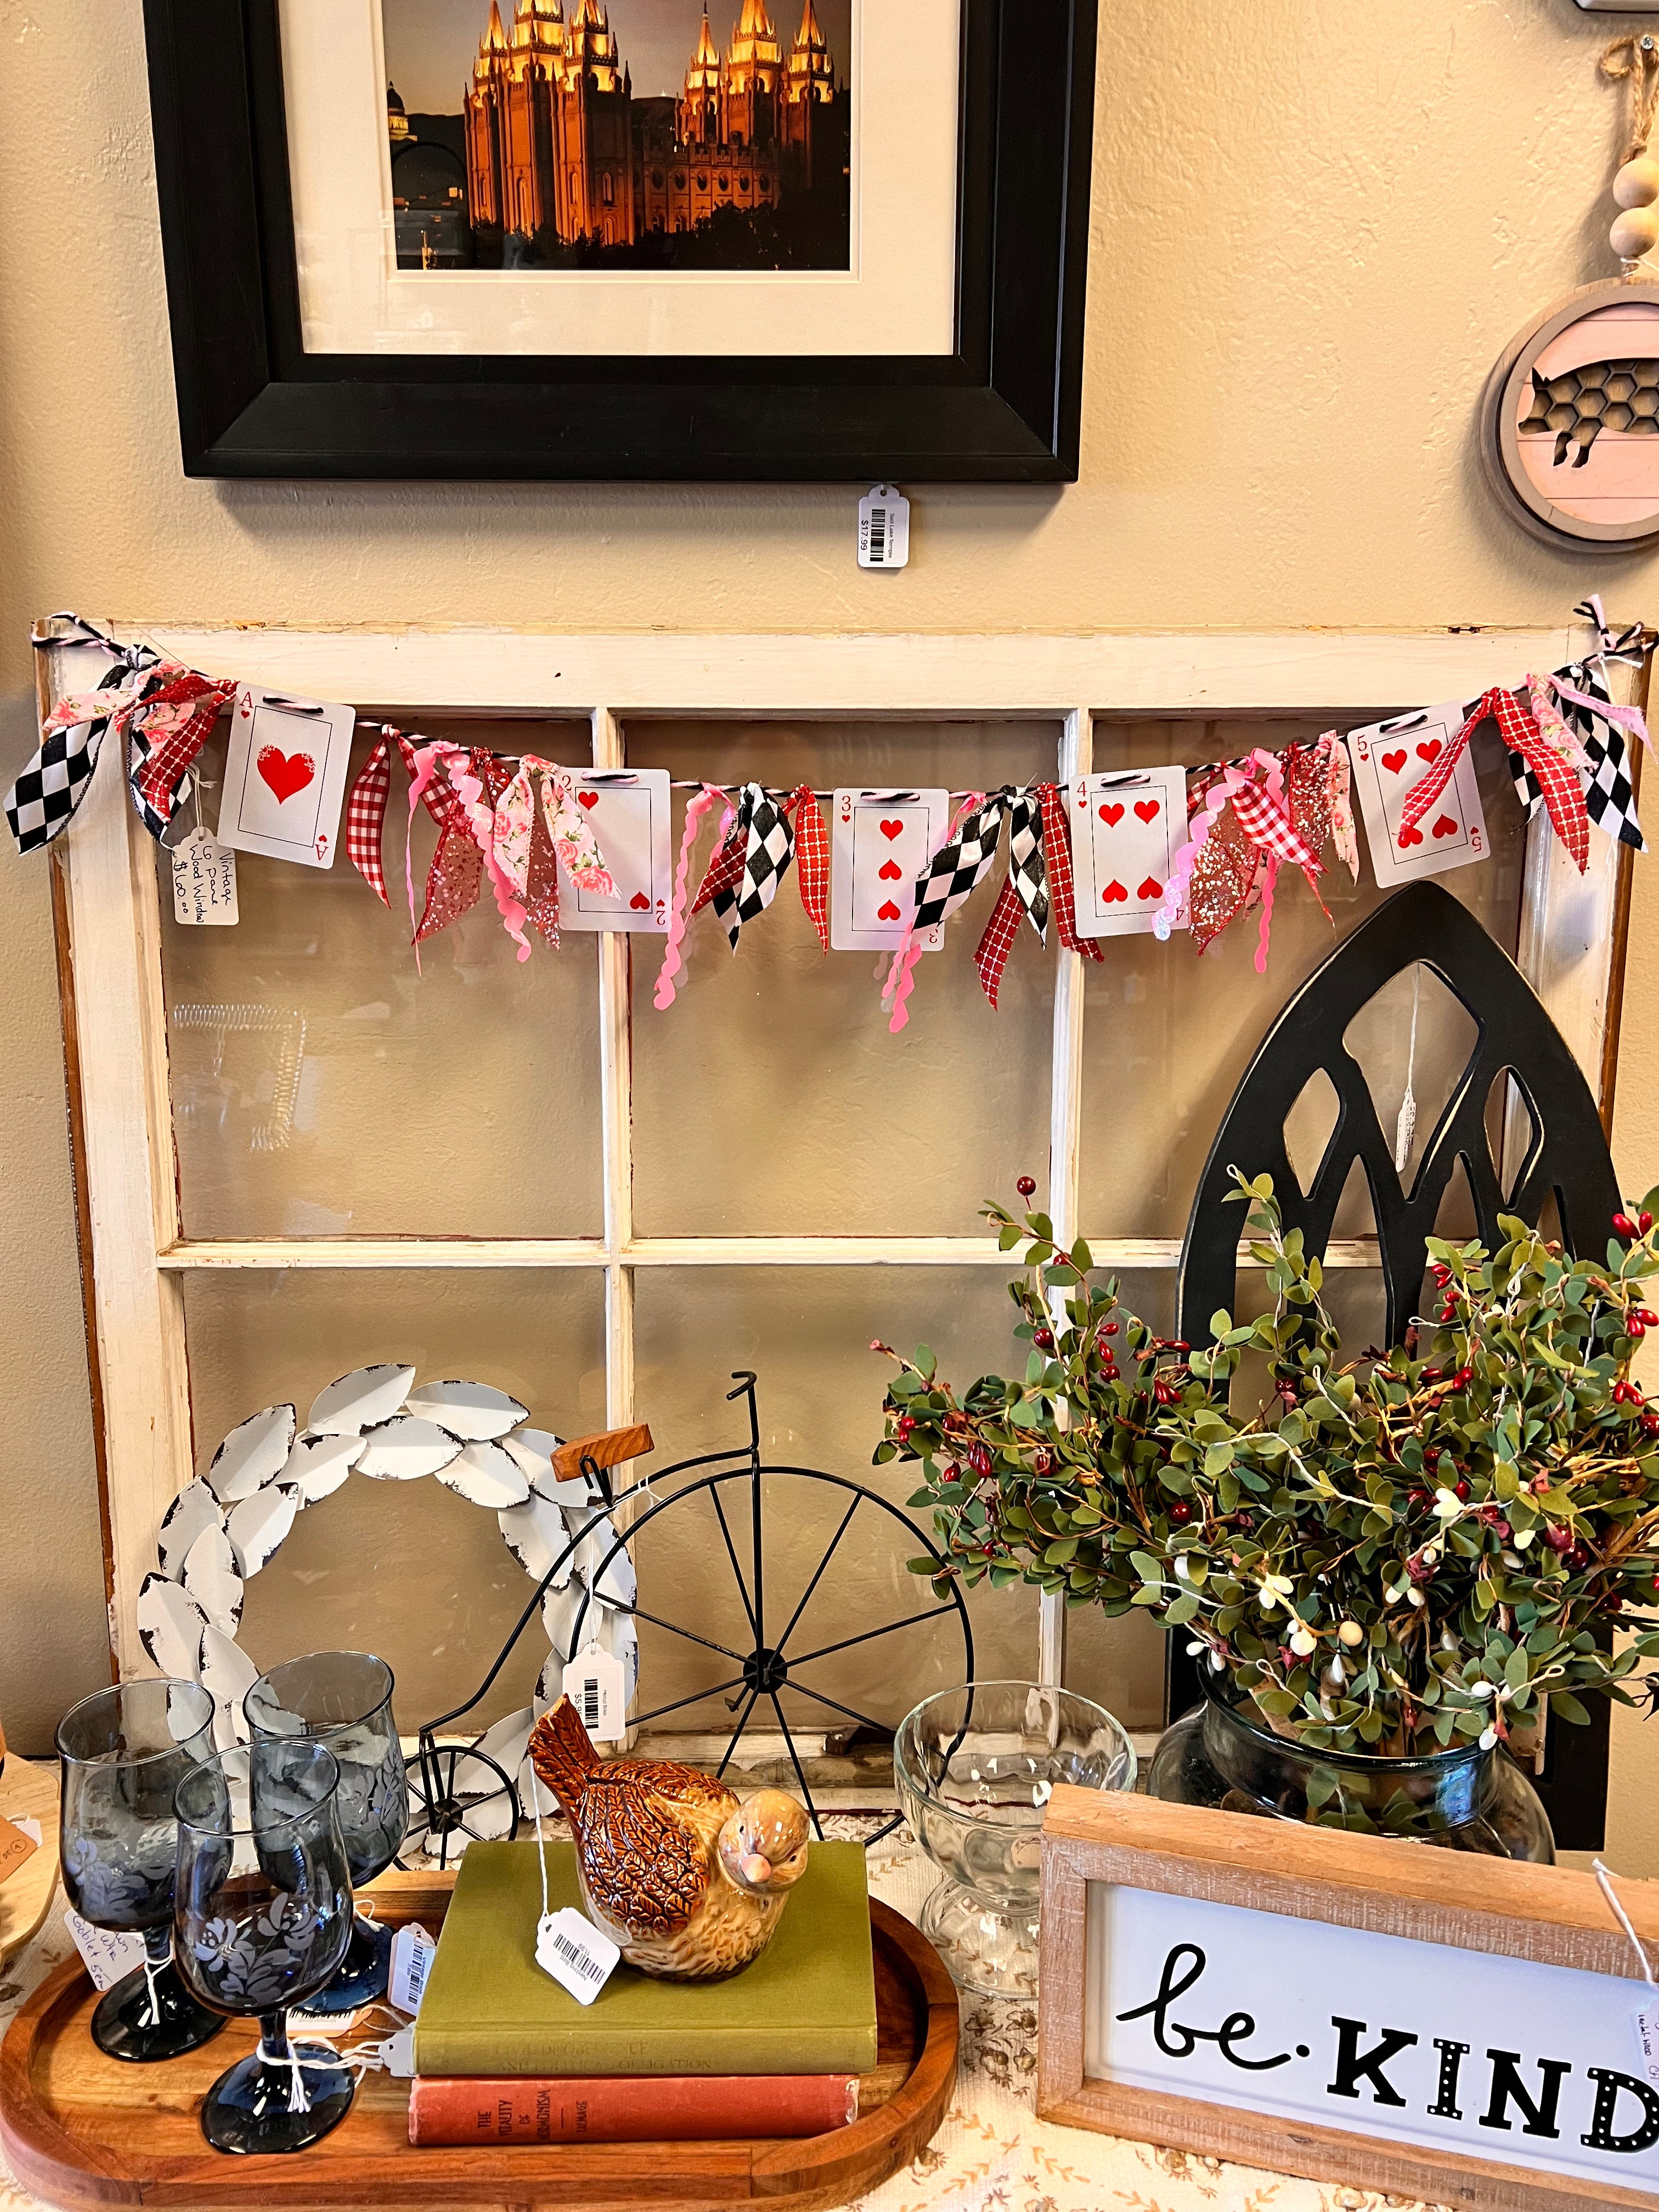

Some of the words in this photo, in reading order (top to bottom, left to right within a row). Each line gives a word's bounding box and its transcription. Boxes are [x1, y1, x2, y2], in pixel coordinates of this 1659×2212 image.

[860, 520, 869, 551] $17.99
[239, 691, 253, 708] A
[1357, 734, 1367, 751] 5
[562, 775, 572, 791] 2
[1077, 781, 1087, 797] 4
[842, 795, 851, 811] 3
[202, 845, 213, 860] 6
[315, 844, 329, 861] A
[1471, 836, 1482, 853] 5
[189, 844, 204, 879] Wood
[218, 852, 235, 906] Vintage
[193, 883, 207, 923] Window
[656, 910, 666, 926] 2
[560, 1955, 570, 1966] Bird
[1327, 2016, 1659, 2153] KIND
[477, 2111, 492, 2129] THE
[498, 2099, 513, 2136] VITALITY
